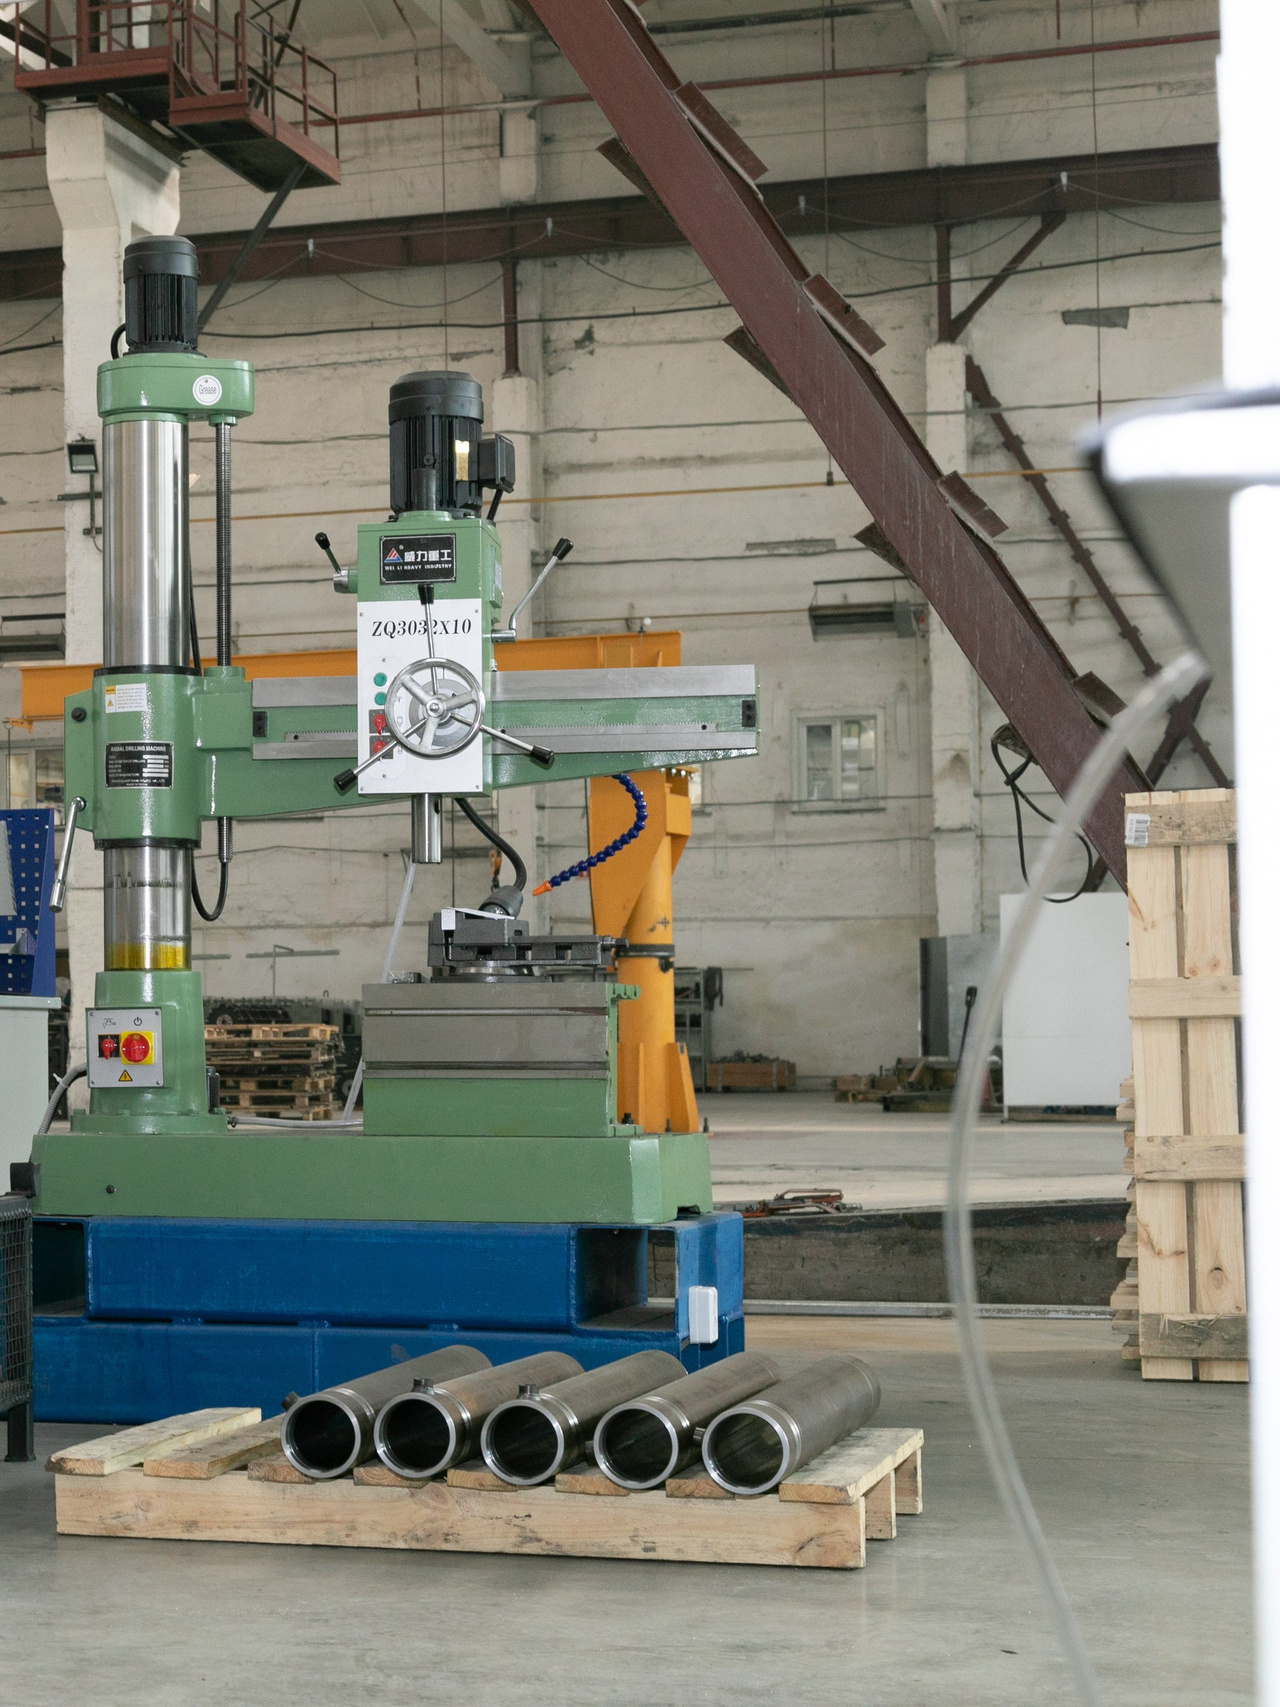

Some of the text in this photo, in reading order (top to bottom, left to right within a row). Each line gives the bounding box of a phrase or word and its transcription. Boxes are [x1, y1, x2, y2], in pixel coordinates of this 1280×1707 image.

[199, 384, 217, 395] Grease
[404, 549, 452, 562] 威力重工
